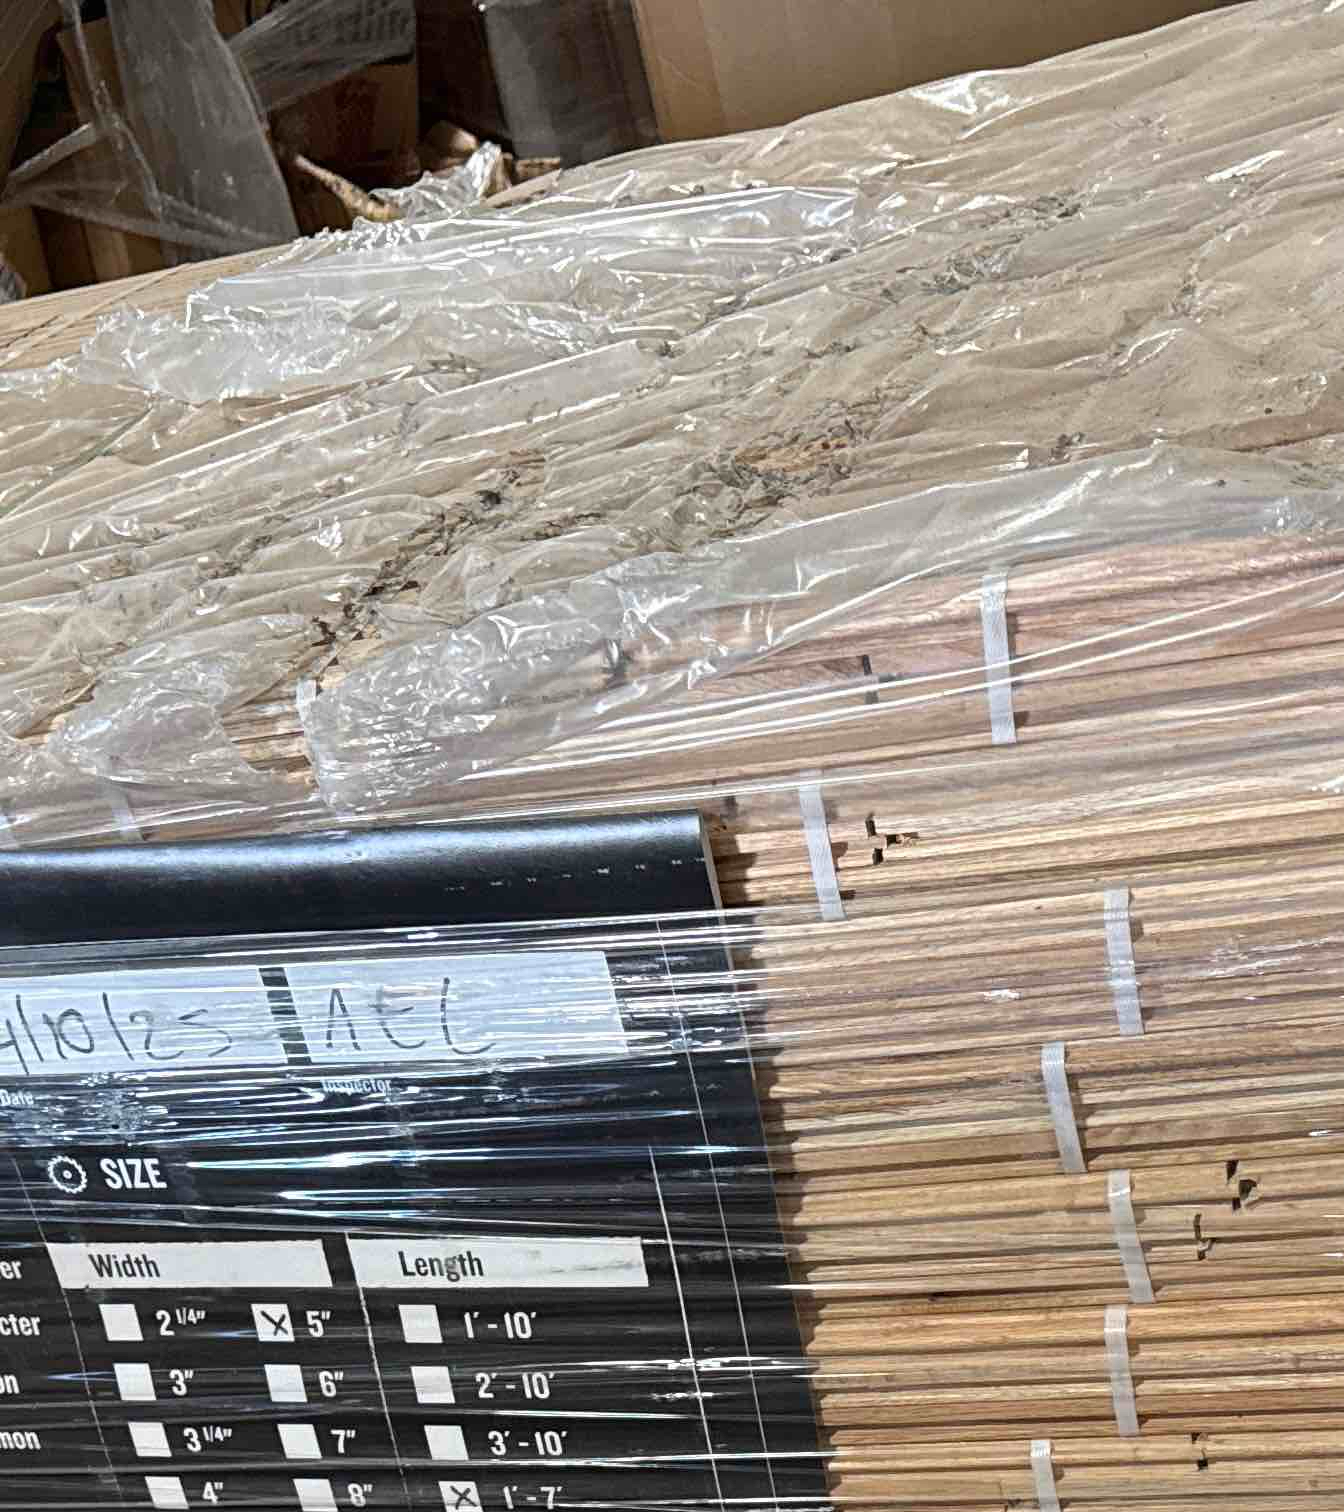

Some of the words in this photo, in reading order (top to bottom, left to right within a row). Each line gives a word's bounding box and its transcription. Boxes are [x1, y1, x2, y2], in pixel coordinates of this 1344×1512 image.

[100, 1158, 167, 1189] SIZE
[88, 1253, 160, 1278] Width
[398, 1250, 484, 1282] Length
